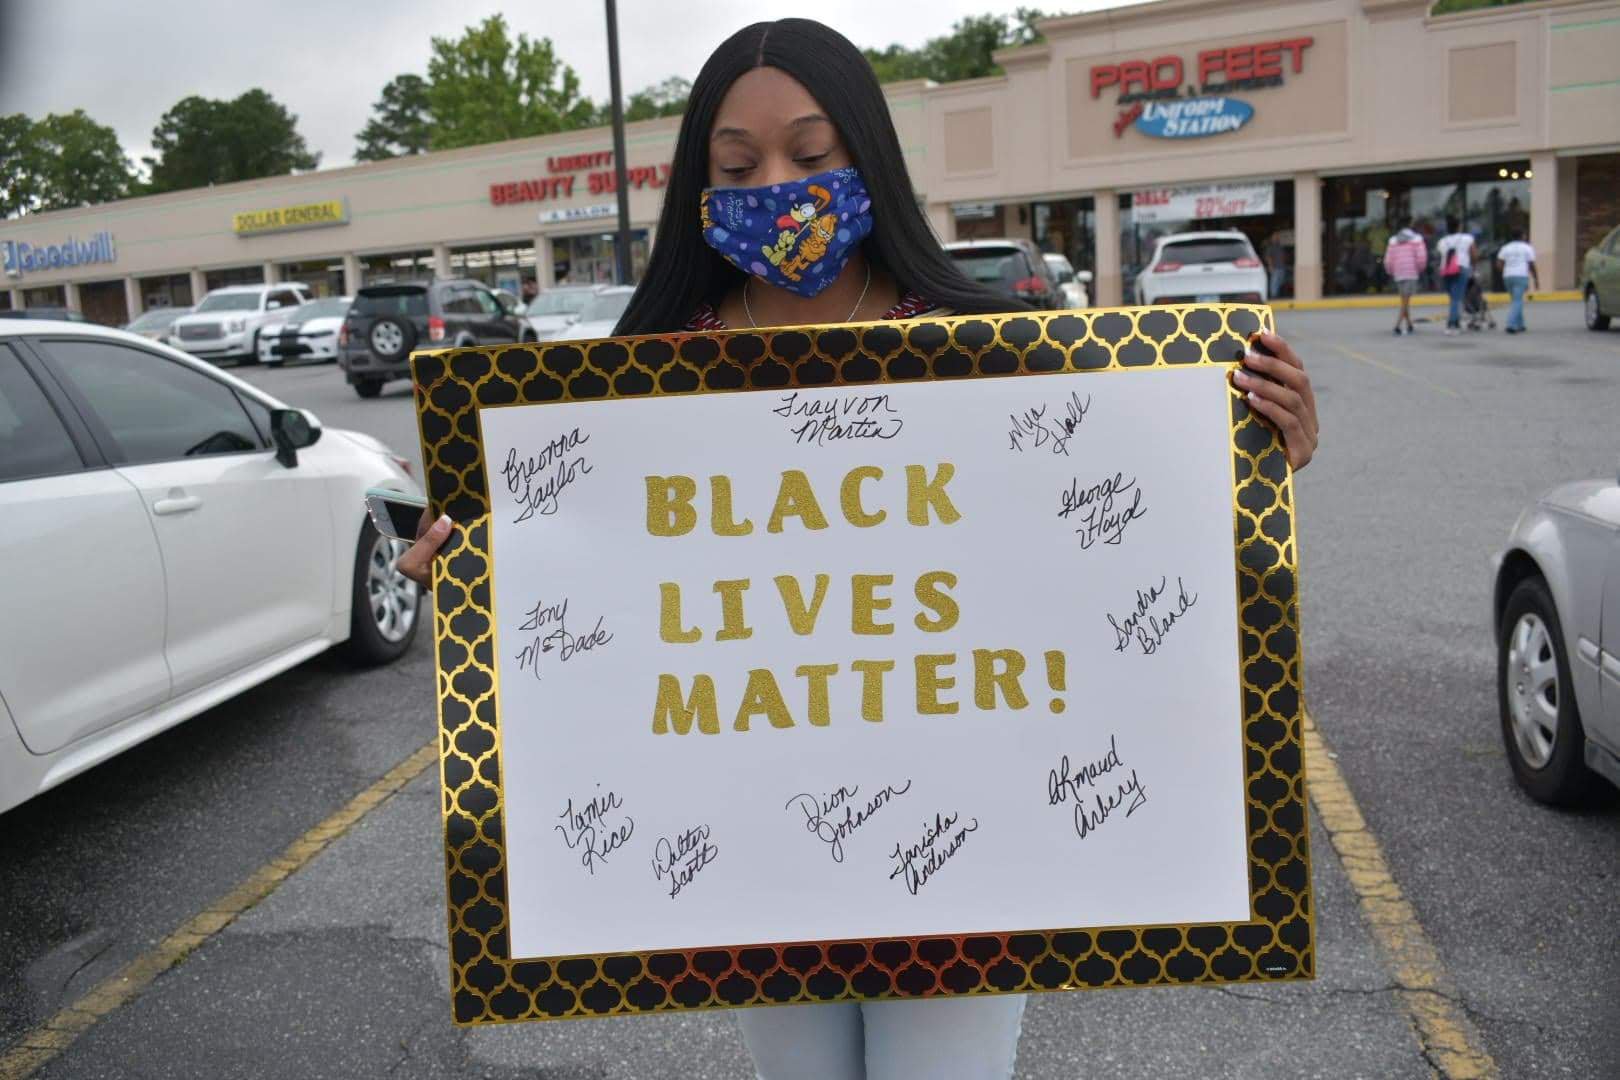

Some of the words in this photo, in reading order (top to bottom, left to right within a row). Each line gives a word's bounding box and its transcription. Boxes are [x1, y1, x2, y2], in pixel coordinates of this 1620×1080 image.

[1089, 55, 1185, 99] PRO
[1197, 36, 1314, 85] FEET
[1162, 114, 1244, 137] STATION
[489, 176, 575, 206] BEAUTY
[18, 231, 114, 272] Goodwill
[773, 392, 898, 429] Trayvon
[790, 416, 903, 447] Martin
[501, 428, 590, 493] Breonna
[513, 457, 593, 524] Taylor
[644, 462, 962, 537] BLACK
[1058, 472, 1136, 519] George
[1076, 488, 1147, 549] Floyd
[519, 597, 568, 638] Tony
[658, 570, 960, 644] LIVES
[1107, 575, 1166, 652] Sandra
[1137, 576, 1198, 655] Bland
[651, 648, 1067, 736] MATTER!
[1049, 734, 1123, 805] Ahmaud
[554, 783, 623, 848] Tamir
[786, 785, 858, 832] Dion
[817, 779, 911, 863] Johnson
[1075, 769, 1146, 839] Arbery
[577, 816, 634, 875] Rice
[652, 823, 710, 880] Walter
[669, 842, 718, 900] Scott
[889, 811, 957, 880] Tanisha
[905, 818, 978, 895] Anderson
